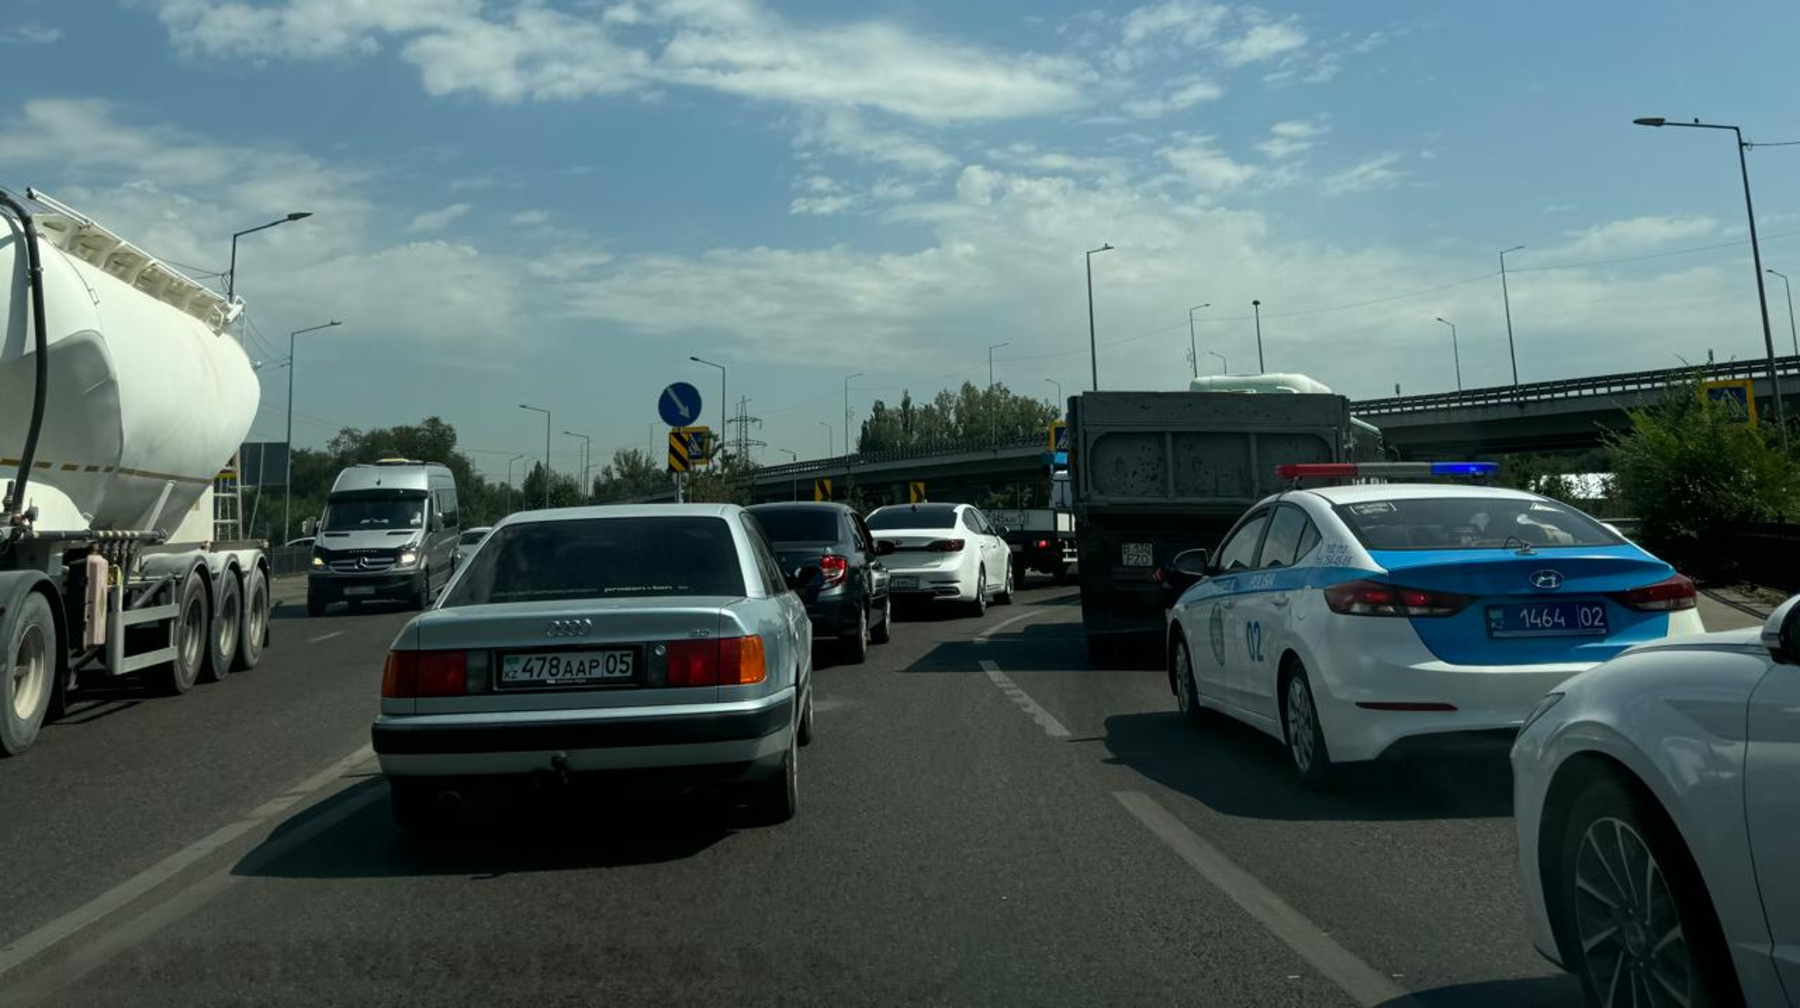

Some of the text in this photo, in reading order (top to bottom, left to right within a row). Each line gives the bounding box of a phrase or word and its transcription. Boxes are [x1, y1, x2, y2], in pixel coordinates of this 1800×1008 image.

[1519, 608, 1567, 628] 1464
[1580, 607, 1605, 627] 02
[1246, 621, 1264, 662] 02
[504, 670, 518, 680] KZ
[605, 653, 632, 675] 05
